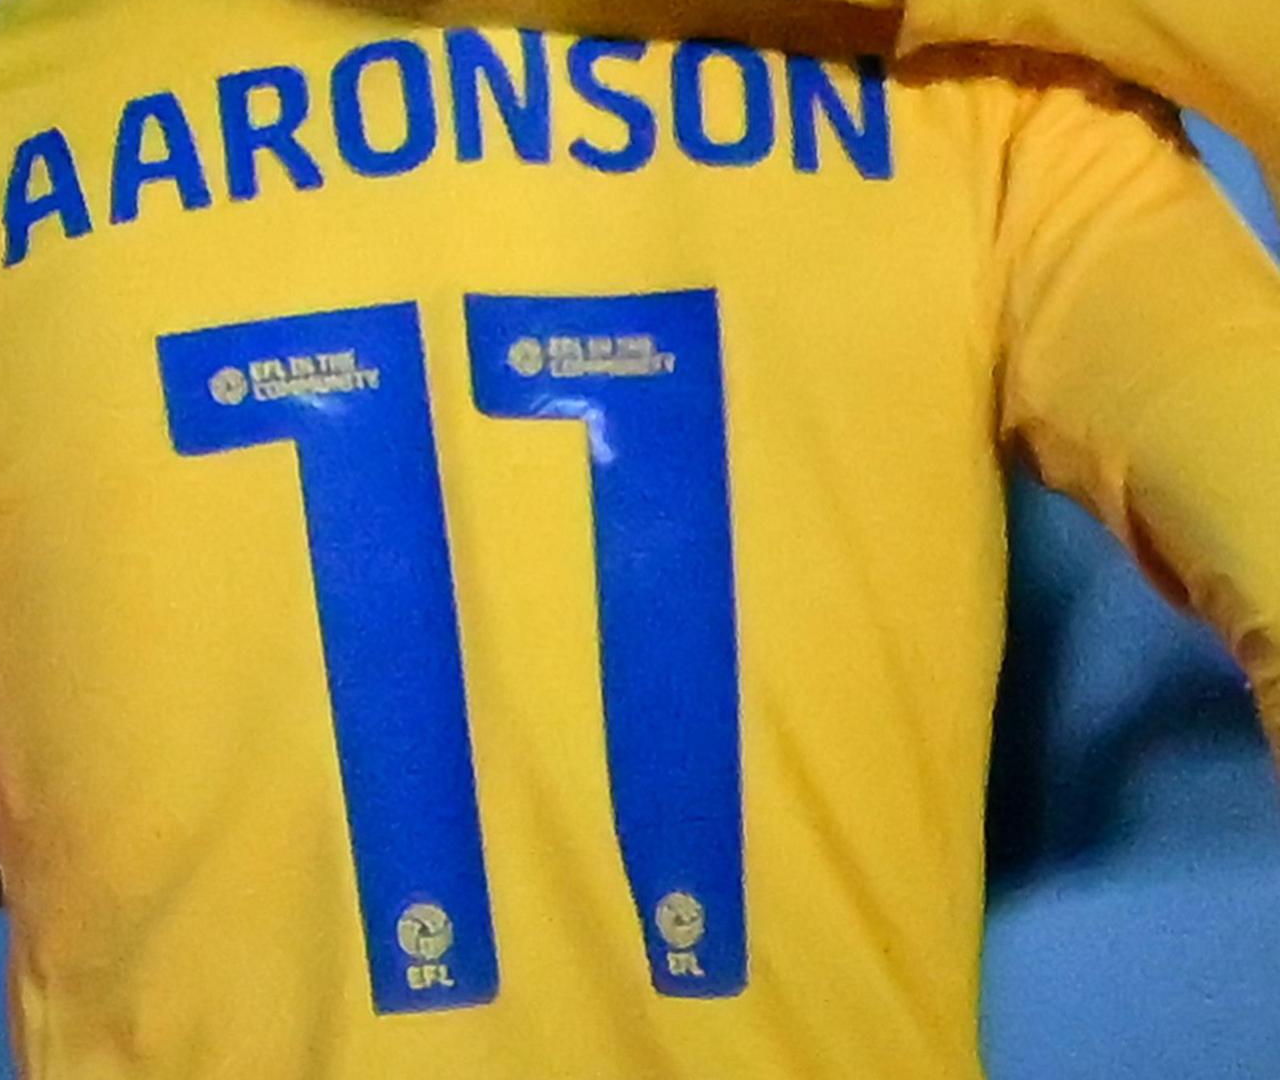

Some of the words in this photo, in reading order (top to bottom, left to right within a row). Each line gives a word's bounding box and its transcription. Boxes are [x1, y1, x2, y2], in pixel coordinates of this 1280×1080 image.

[2, 26, 893, 269] AARONSON
[154, 287, 750, 1017] 11
[406, 964, 455, 990] EFL
